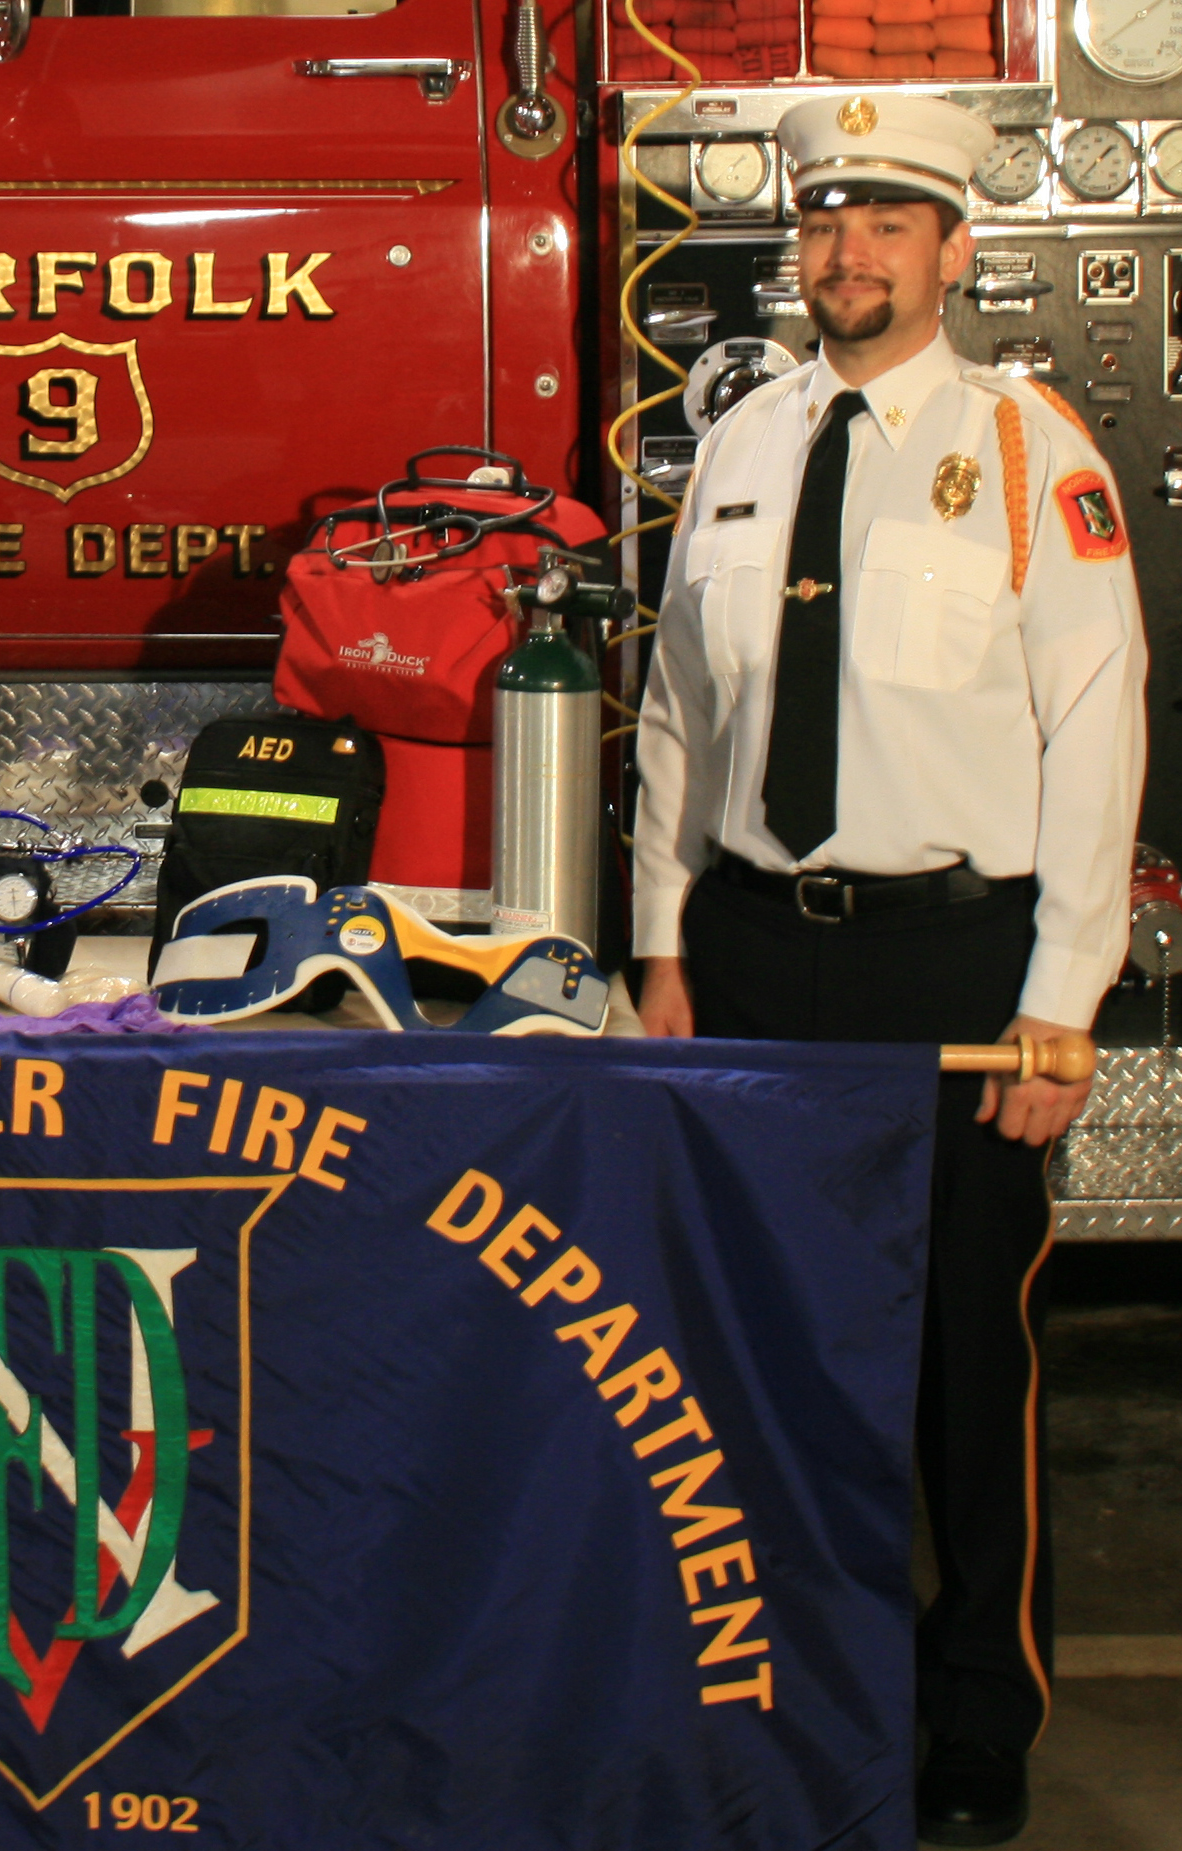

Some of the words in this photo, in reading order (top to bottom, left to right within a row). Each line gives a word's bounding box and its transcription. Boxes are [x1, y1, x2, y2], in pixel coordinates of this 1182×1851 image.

[22, 367, 99, 458] 9
[68, 523, 275, 577] DEPT.
[339, 645, 372, 660] IRON
[386, 650, 425, 667] DUCK
[237, 735, 294, 761] AED
[152, 1069, 368, 1192] FIRE
[425, 1168, 774, 1712] DEPARTMENT
[81, 1791, 200, 1833] 1902
